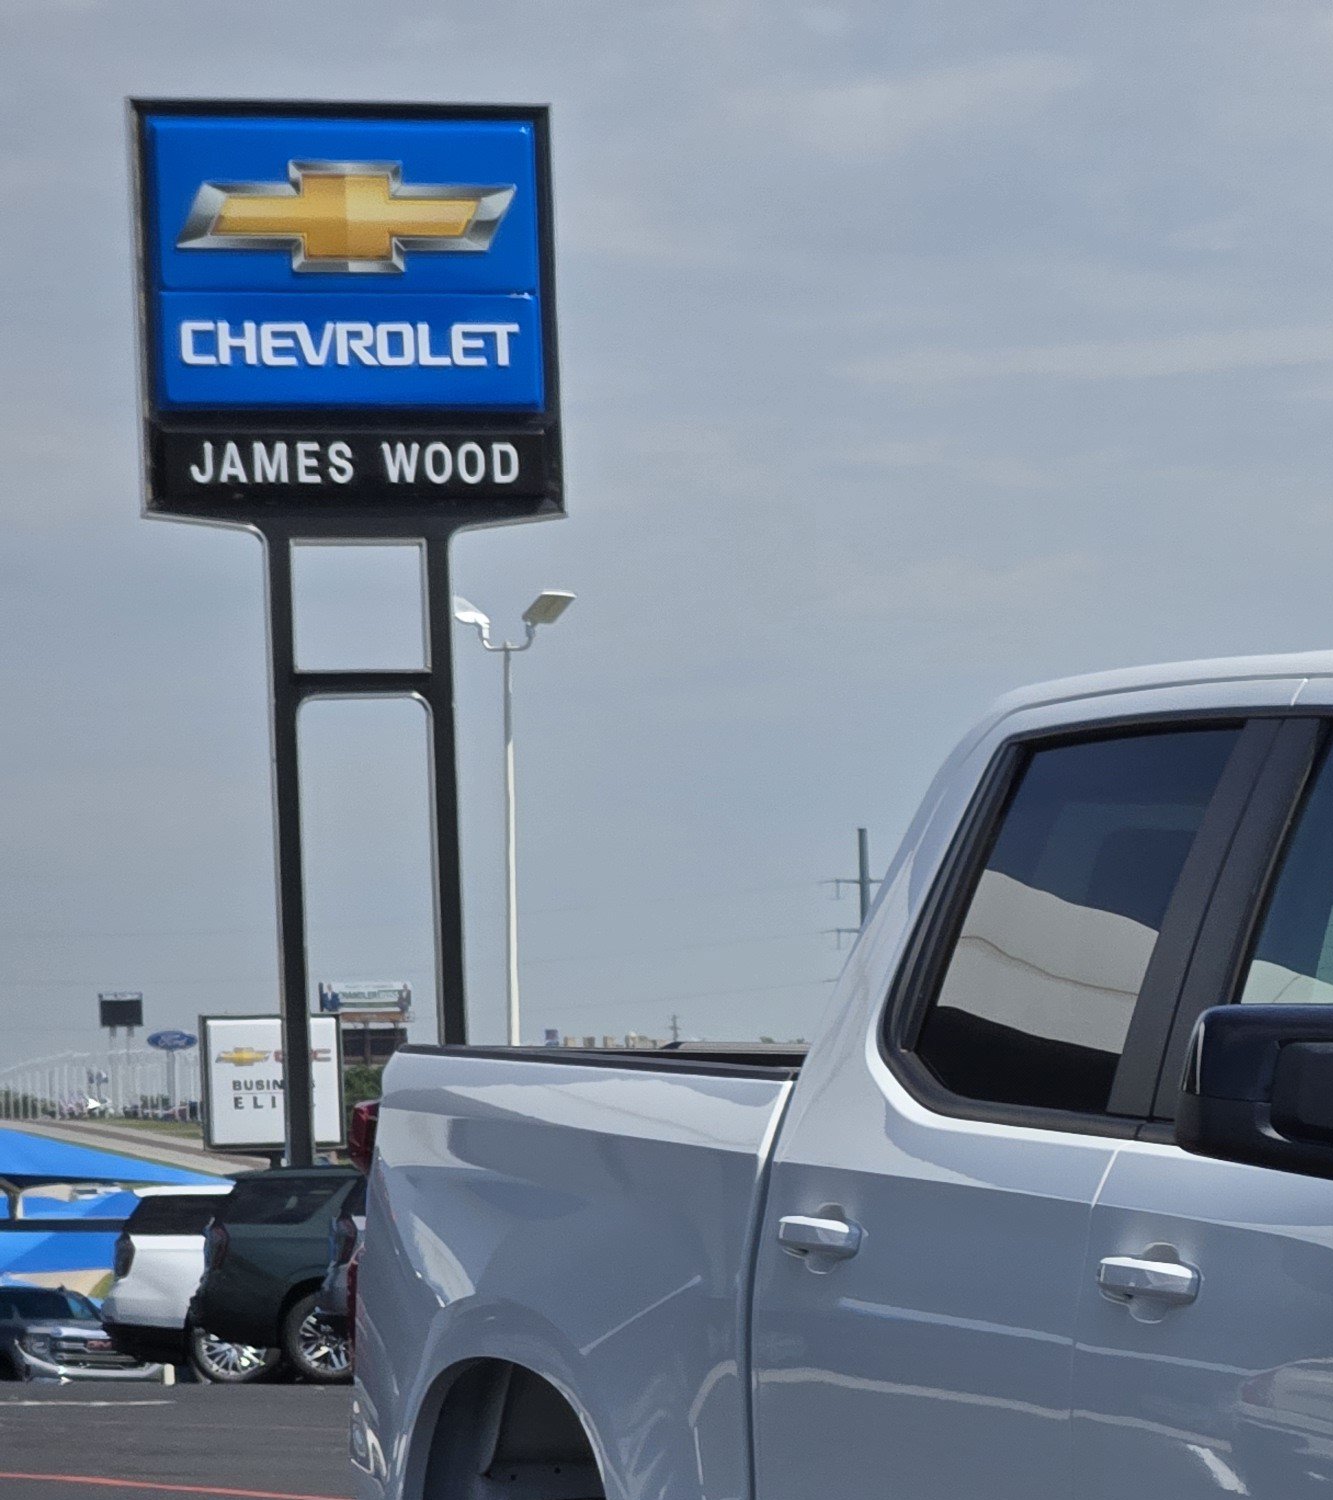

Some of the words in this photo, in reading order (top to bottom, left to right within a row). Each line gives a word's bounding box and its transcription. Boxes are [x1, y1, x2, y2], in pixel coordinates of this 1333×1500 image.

[180, 320, 520, 367] CHEVROLET
[189, 439, 354, 485] JAMES
[381, 441, 520, 485] WOOD
[231, 1078, 305, 1092] BUSIN
[233, 1096, 300, 1110] ELI
